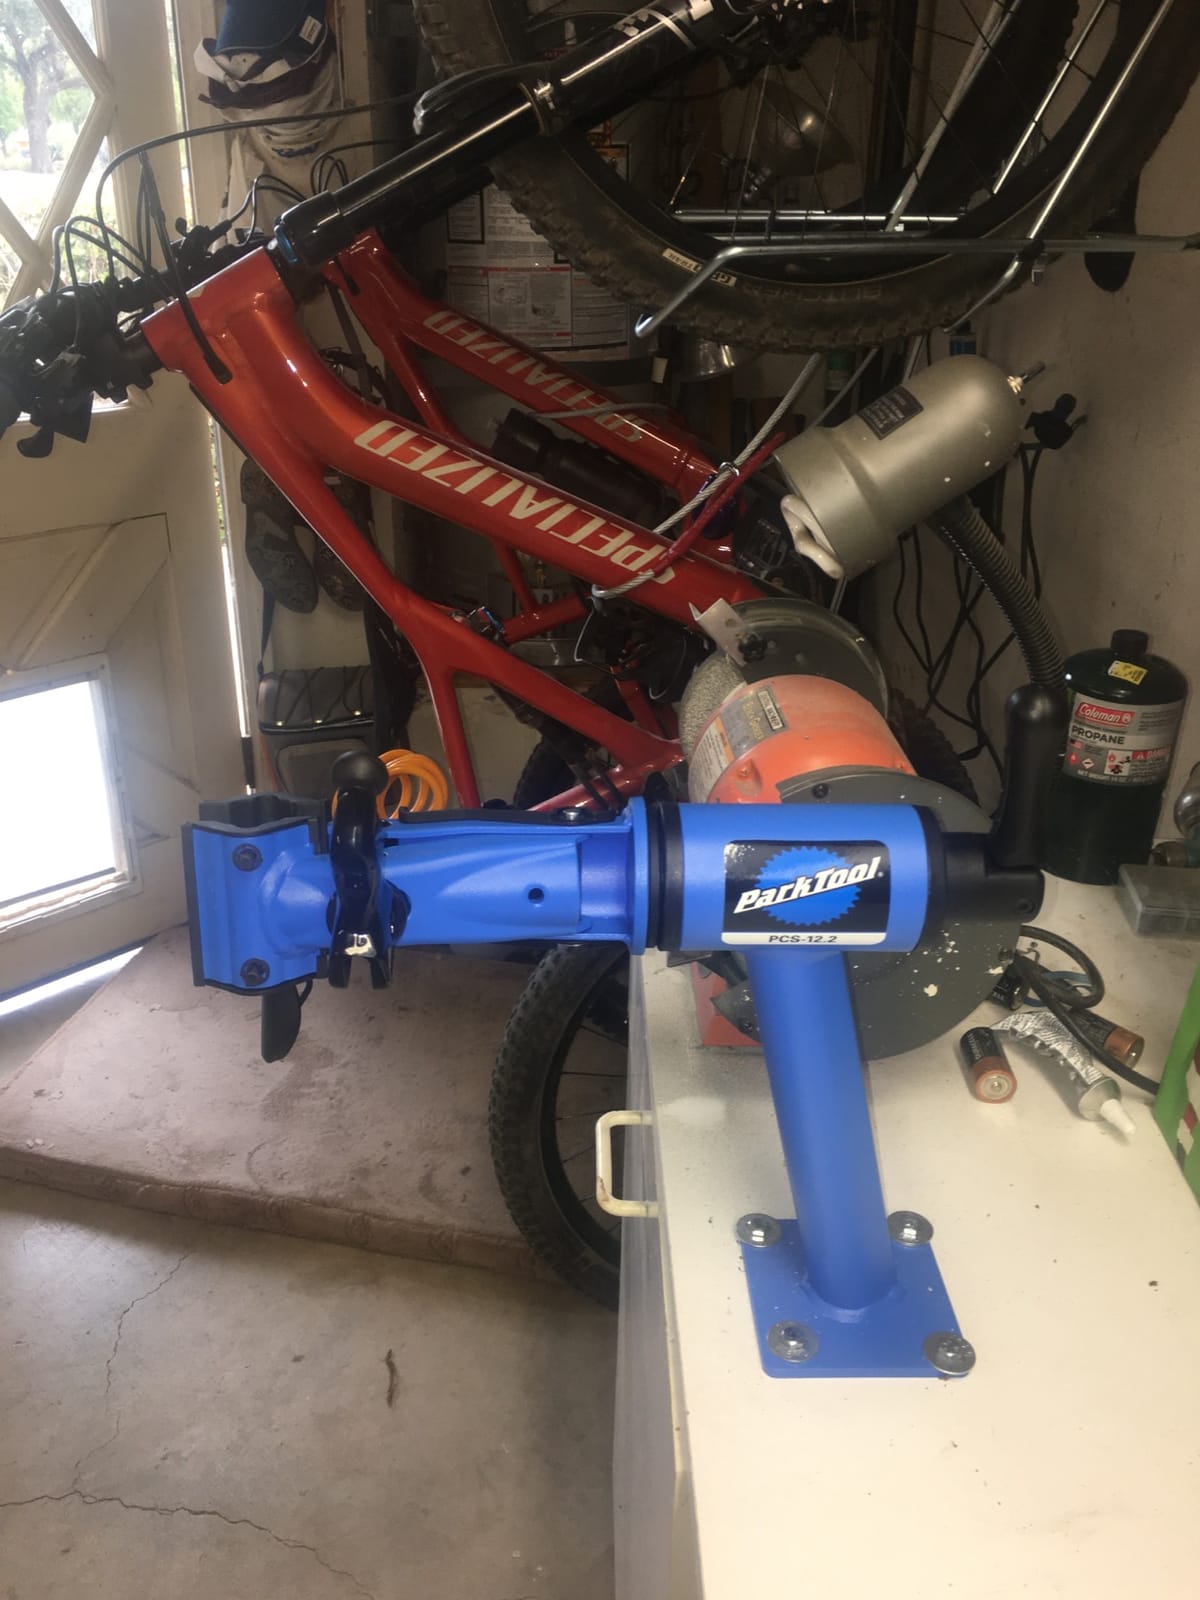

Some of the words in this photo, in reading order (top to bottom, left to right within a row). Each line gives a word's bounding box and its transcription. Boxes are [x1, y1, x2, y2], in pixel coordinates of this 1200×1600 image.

[1080, 704, 1120, 723] Coleman
[1071, 725, 1125, 745] PROPANE
[768, 935, 837, 943] PCS-12.2
